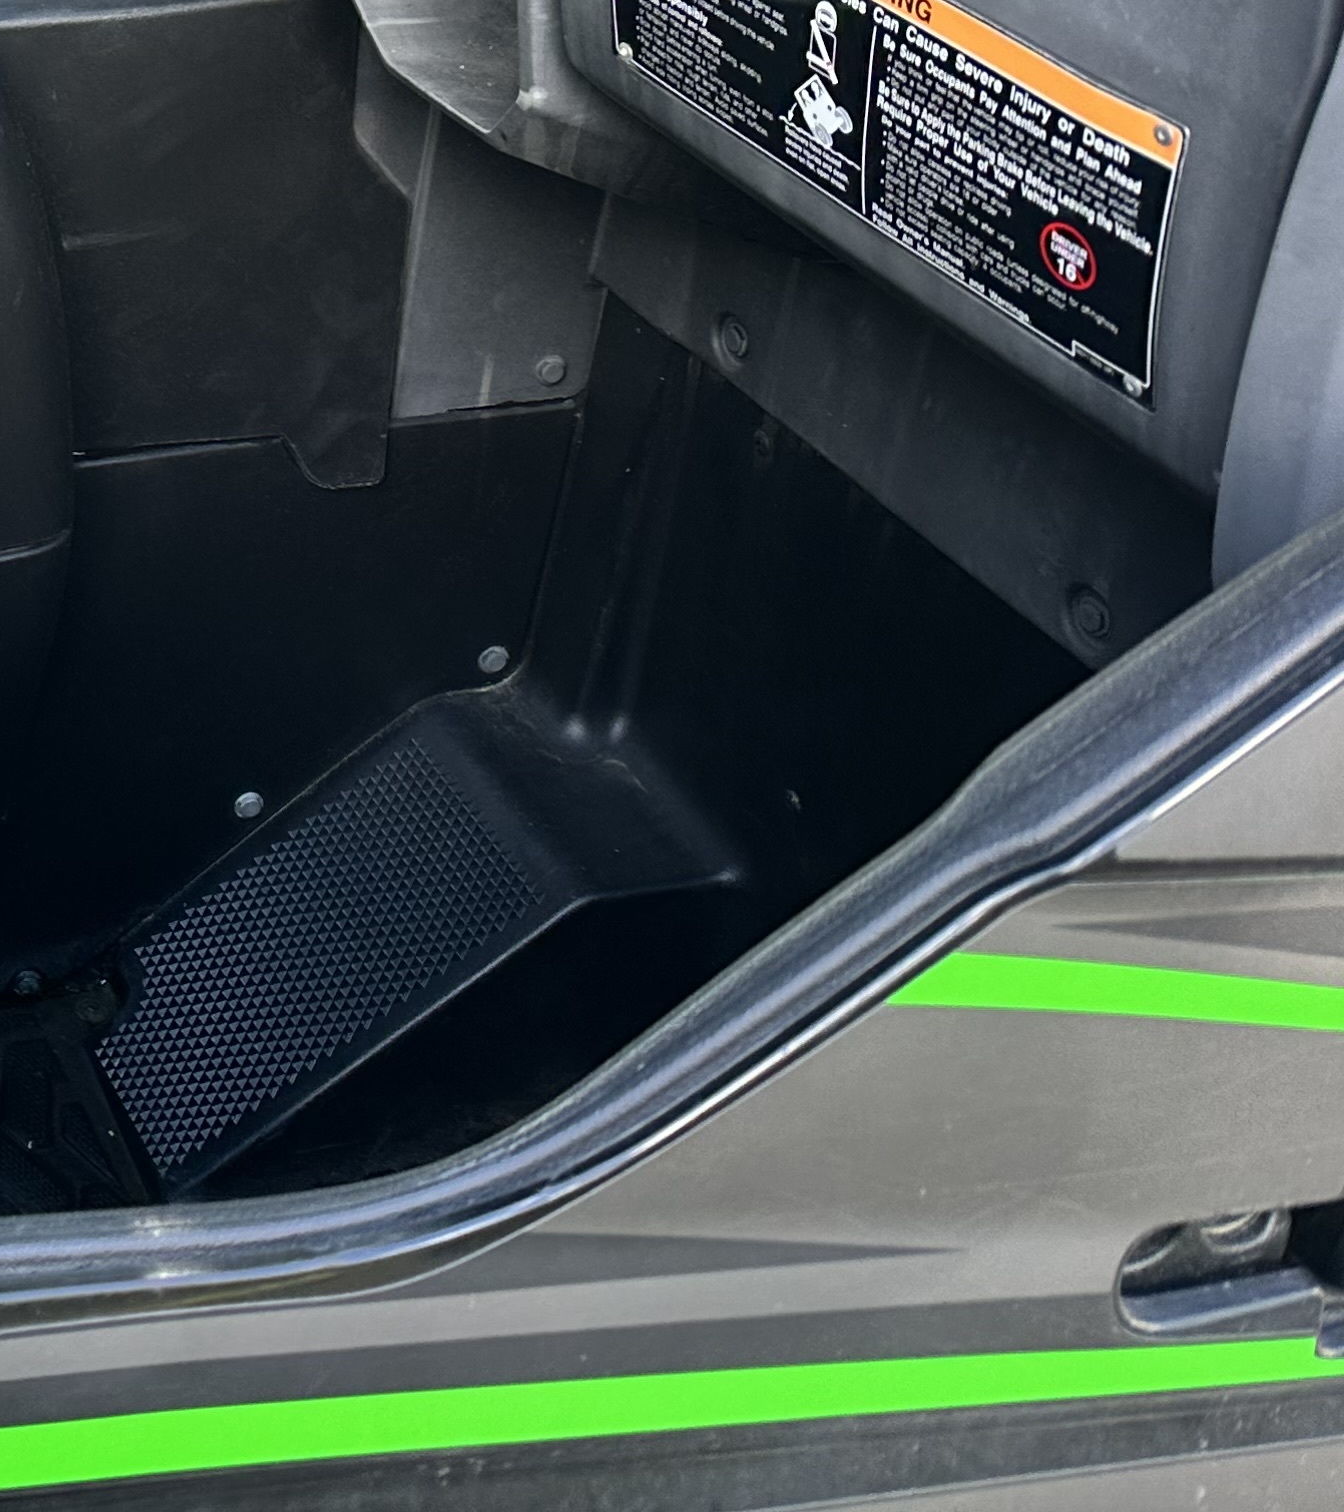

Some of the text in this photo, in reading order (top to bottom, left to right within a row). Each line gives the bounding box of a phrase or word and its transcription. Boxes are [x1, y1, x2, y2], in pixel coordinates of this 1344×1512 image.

[873, 6, 899, 33] Can
[905, 25, 948, 61] Cause
[954, 53, 1002, 93] Severe
[1009, 85, 1051, 124] Injury
[1057, 117, 1075, 134] or
[1082, 127, 1129, 166] Death
[882, 33, 1142, 194] Be Sure Occupants Pay Attention and Plan Ahead
[876, 94, 912, 126] Require
[916, 119, 948, 148] Proper
[953, 141, 972, 163] Use
[977, 159, 988, 172] of
[993, 165, 1015, 188] Your
[1020, 182, 1058, 215] Vehicle
[878, 79, 890, 97] Be
[891, 87, 910, 110] Sure
[911, 101, 919, 116] to
[920, 107, 945, 133] Apply
[946, 123, 961, 141] the
[962, 130, 995, 165] Parking
[997, 152, 1023, 179] Brake
[1024, 169, 1055, 198] Before
[1057, 188, 1095, 224] Leaving
[1096, 212, 1112, 231] the
[1050, 240, 1085, 269] UNDER
[1051, 230, 1088, 261] DRIVER
[1057, 257, 1077, 283] 16
